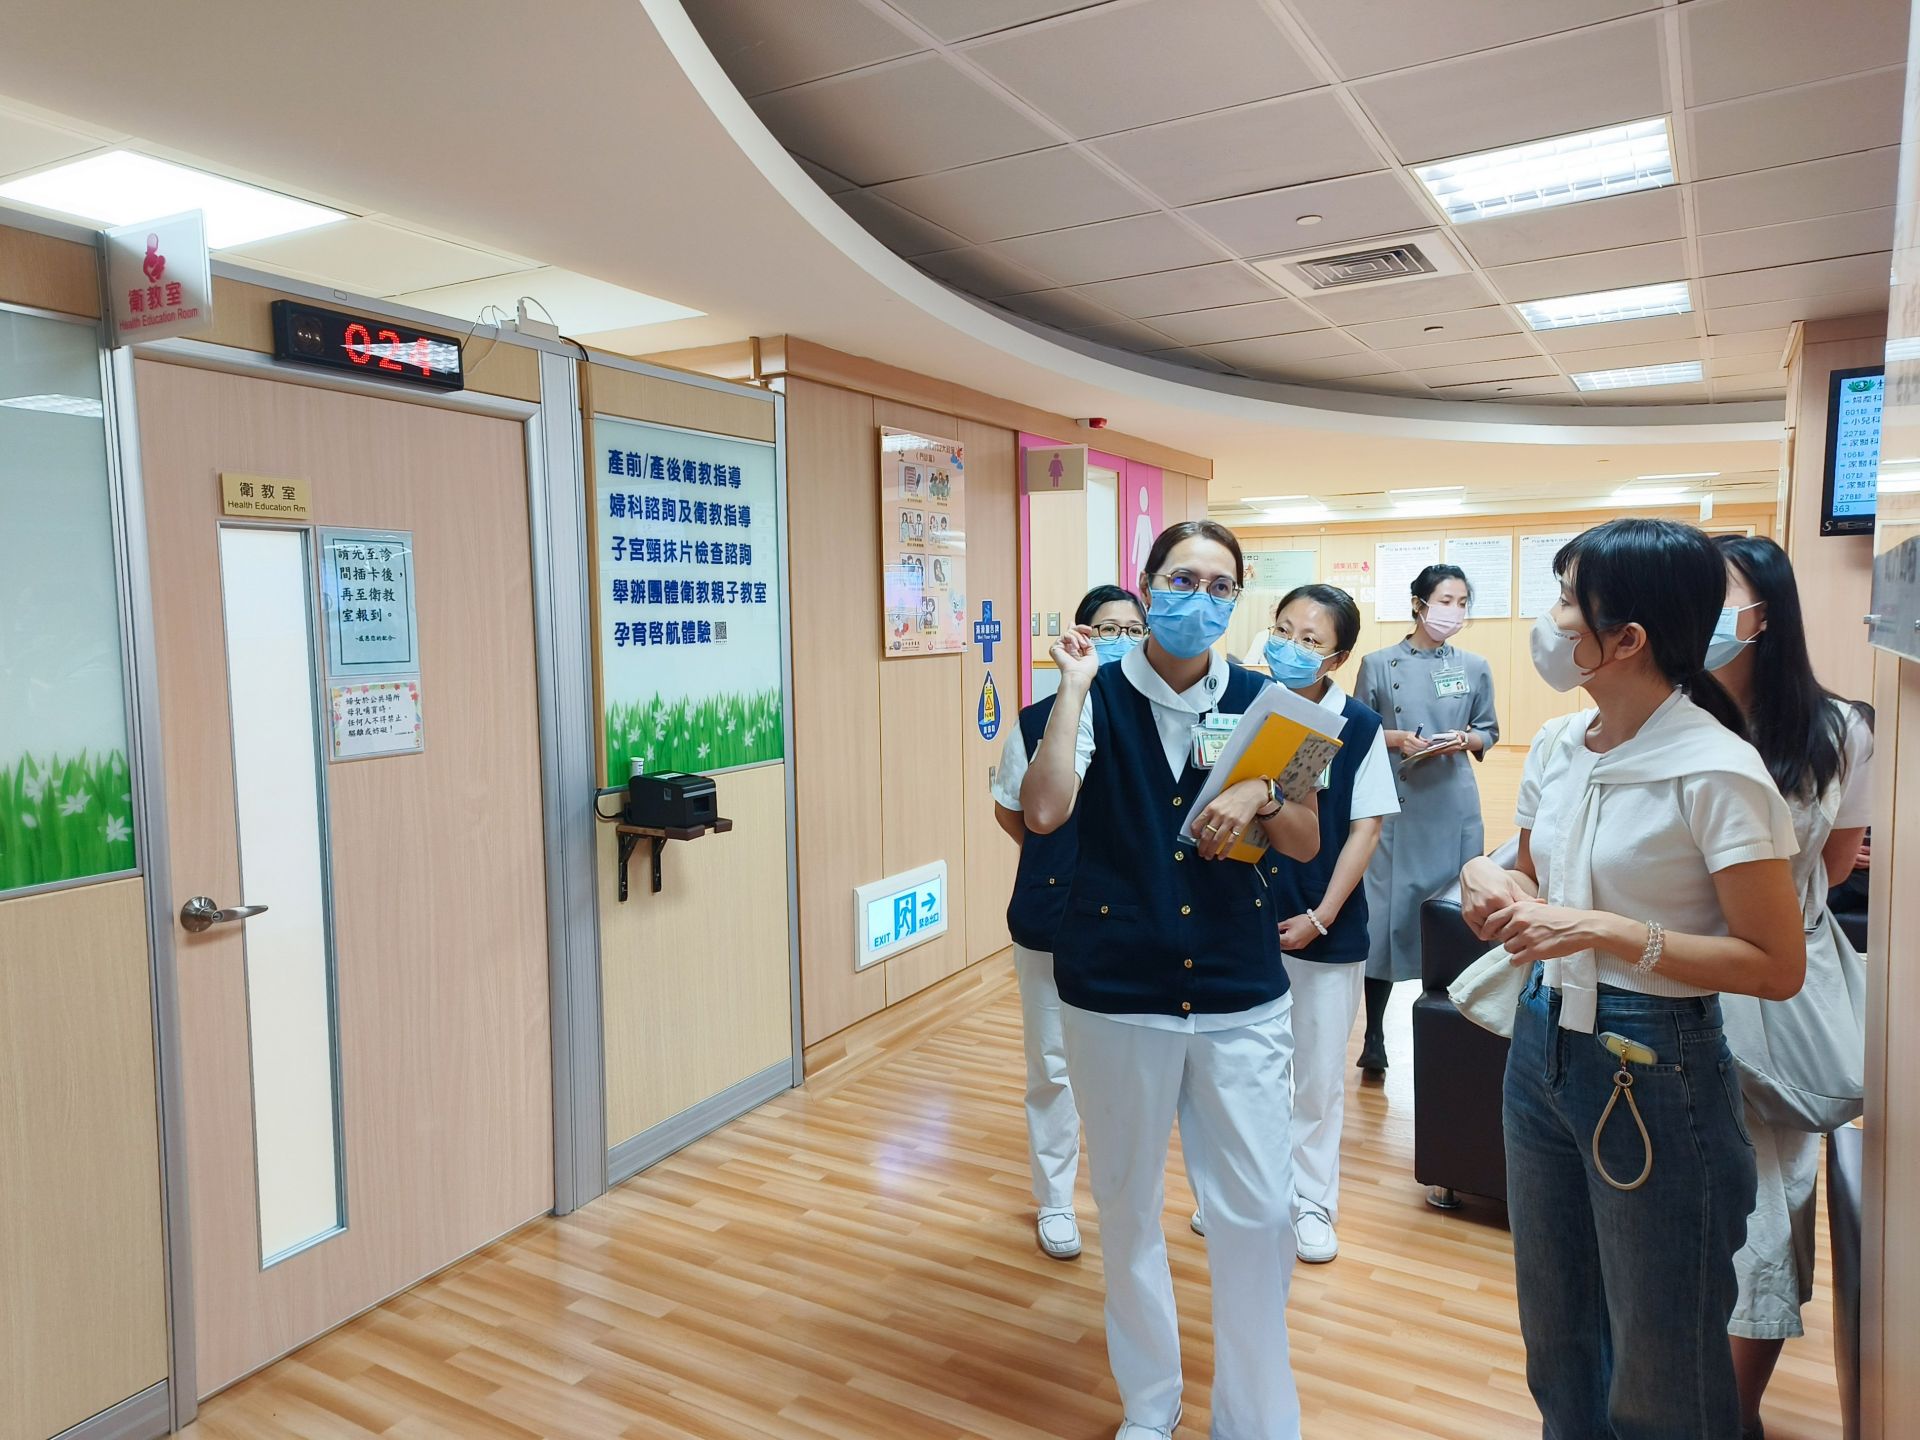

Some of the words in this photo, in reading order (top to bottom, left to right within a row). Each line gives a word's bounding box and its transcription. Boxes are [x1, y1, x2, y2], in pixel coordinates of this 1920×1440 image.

[128, 281, 182, 313] 衛教室
[119, 317, 141, 331] Health
[142, 311, 176, 327] Education
[177, 307, 199, 320] Room
[344, 323, 431, 376] 024
[608, 449, 742, 489] 產前/產後衛教指導
[239, 482, 296, 501] 衛教室
[228, 500, 253, 510] Health
[255, 501, 292, 512] Education
[293, 504, 306, 513] Rm
[609, 493, 752, 528] 婦科諮詢及衛教指導
[1833, 505, 1850, 513] 363
[611, 536, 752, 566] 子宮頸抹片檢查諮詢
[340, 587, 396, 602] 再至衛教
[612, 579, 767, 605] 舉辦團體衛教親子教室
[342, 607, 392, 622] 室報到。
[874, 932, 891, 948] EXIT
